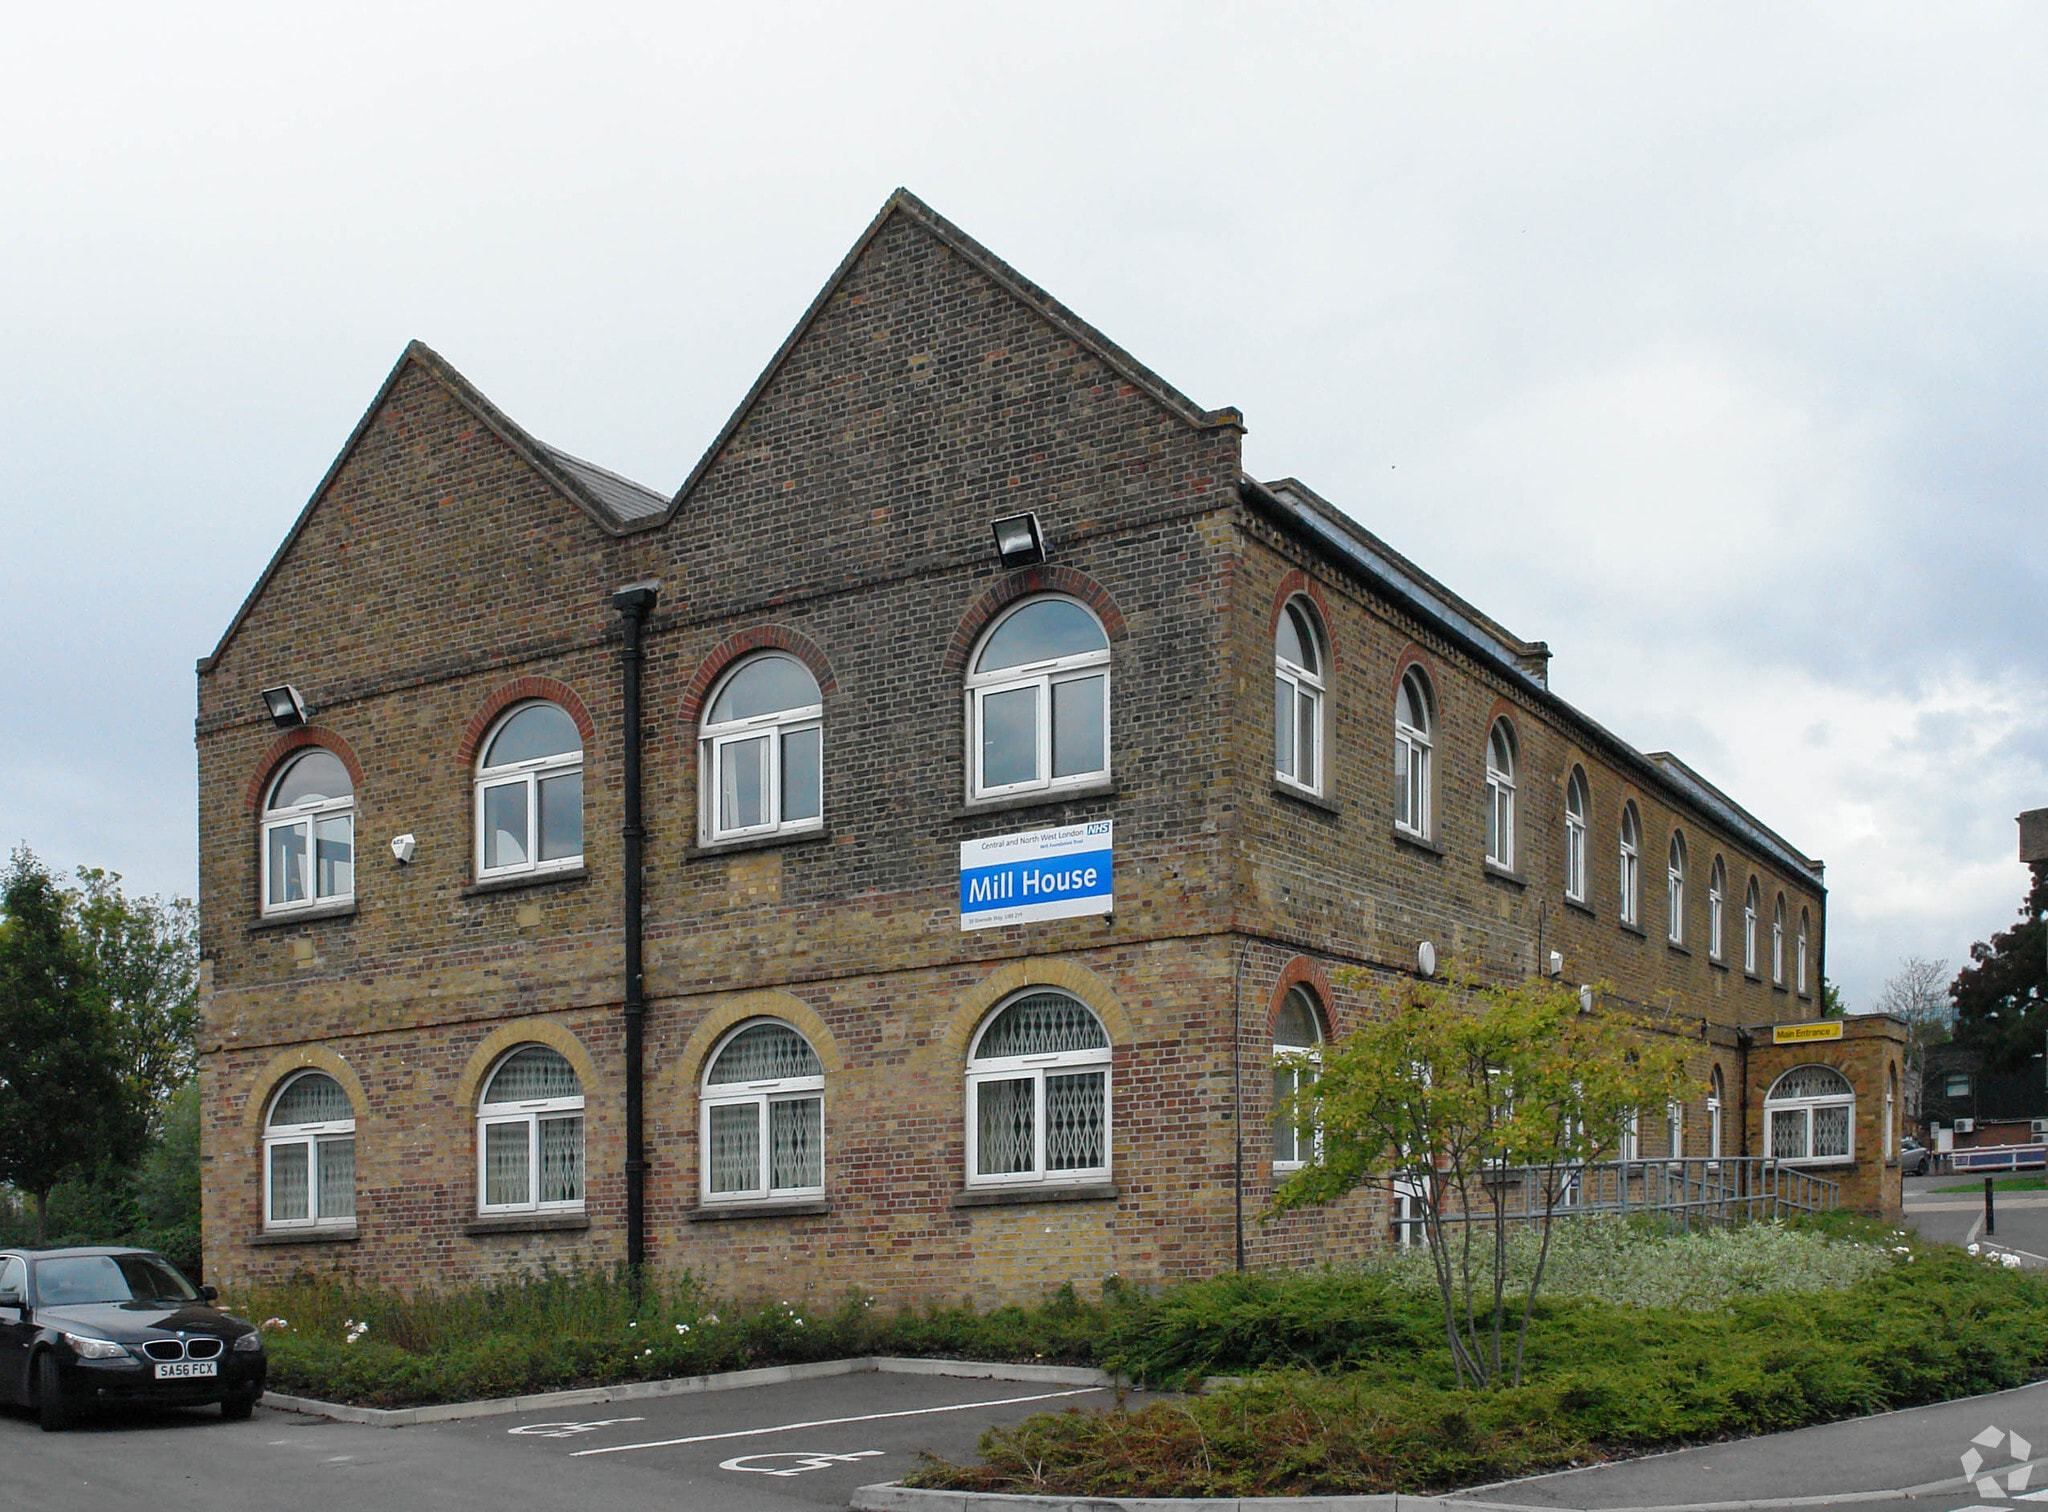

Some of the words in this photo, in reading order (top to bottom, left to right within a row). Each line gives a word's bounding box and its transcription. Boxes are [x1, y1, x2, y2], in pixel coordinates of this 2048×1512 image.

[1087, 823, 1110, 835] NHS
[981, 840, 1004, 850] Central
[1006, 838, 1019, 847] and
[1020, 835, 1039, 845] North
[1040, 832, 1057, 841] West
[1058, 830, 1084, 839] London
[968, 871, 1013, 904] Mill
[1022, 867, 1098, 896] House
[1776, 1030, 1795, 1038] Main
[1795, 1028, 1831, 1037] Entrance
[160, 1364, 190, 1376] SA56
[192, 1363, 213, 1374] FCX
